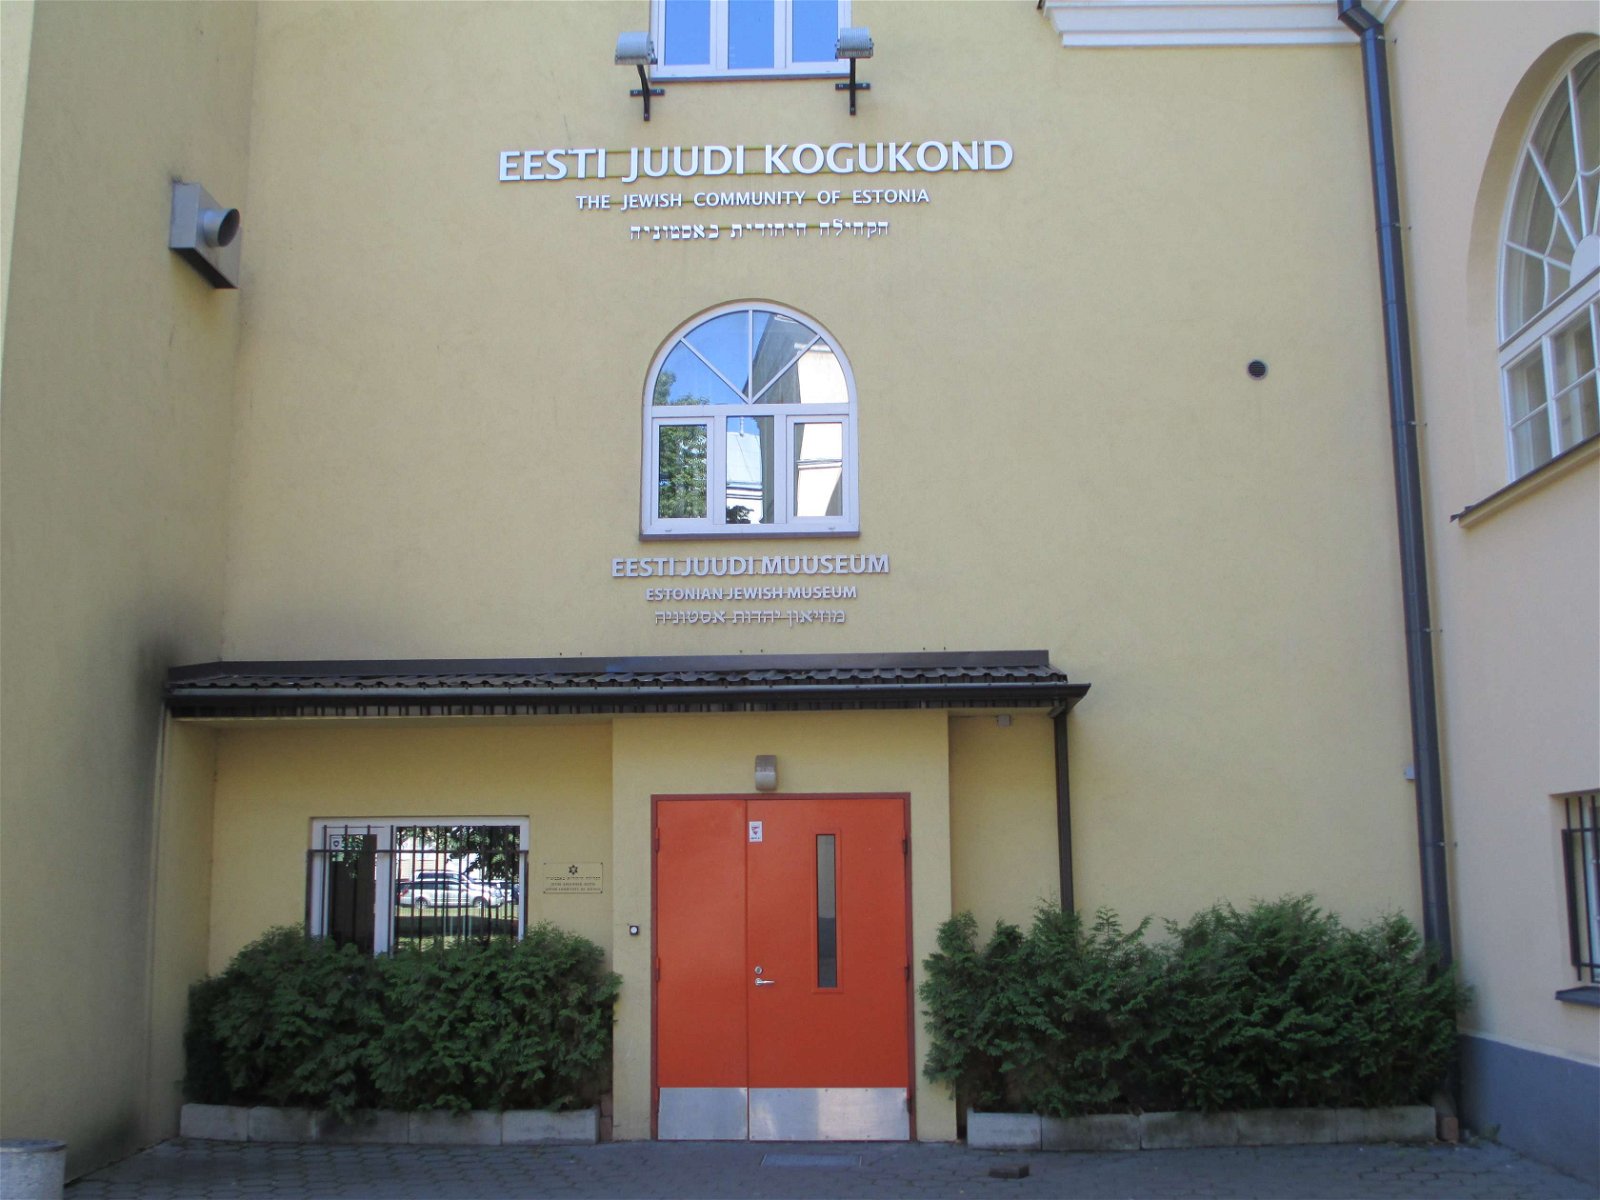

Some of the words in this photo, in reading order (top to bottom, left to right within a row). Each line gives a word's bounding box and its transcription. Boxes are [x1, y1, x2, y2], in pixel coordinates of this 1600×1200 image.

[499, 149, 606, 182] EESTI
[621, 144, 745, 184] JUUDI
[764, 140, 1014, 175] KOGUKOND
[576, 194, 611, 210] THE
[621, 192, 683, 211] JEWISH
[693, 190, 805, 207] COMMUNITY
[816, 190, 841, 205] OF
[852, 188, 930, 204] ESTONIA
[611, 557, 675, 577] EESTI
[681, 556, 754, 577] JUUDI
[761, 554, 890, 575] MUUSEUM
[646, 587, 723, 601] ESTONIAN
[726, 586, 784, 600] JEWISH
[787, 585, 857, 599] MUSEUM
